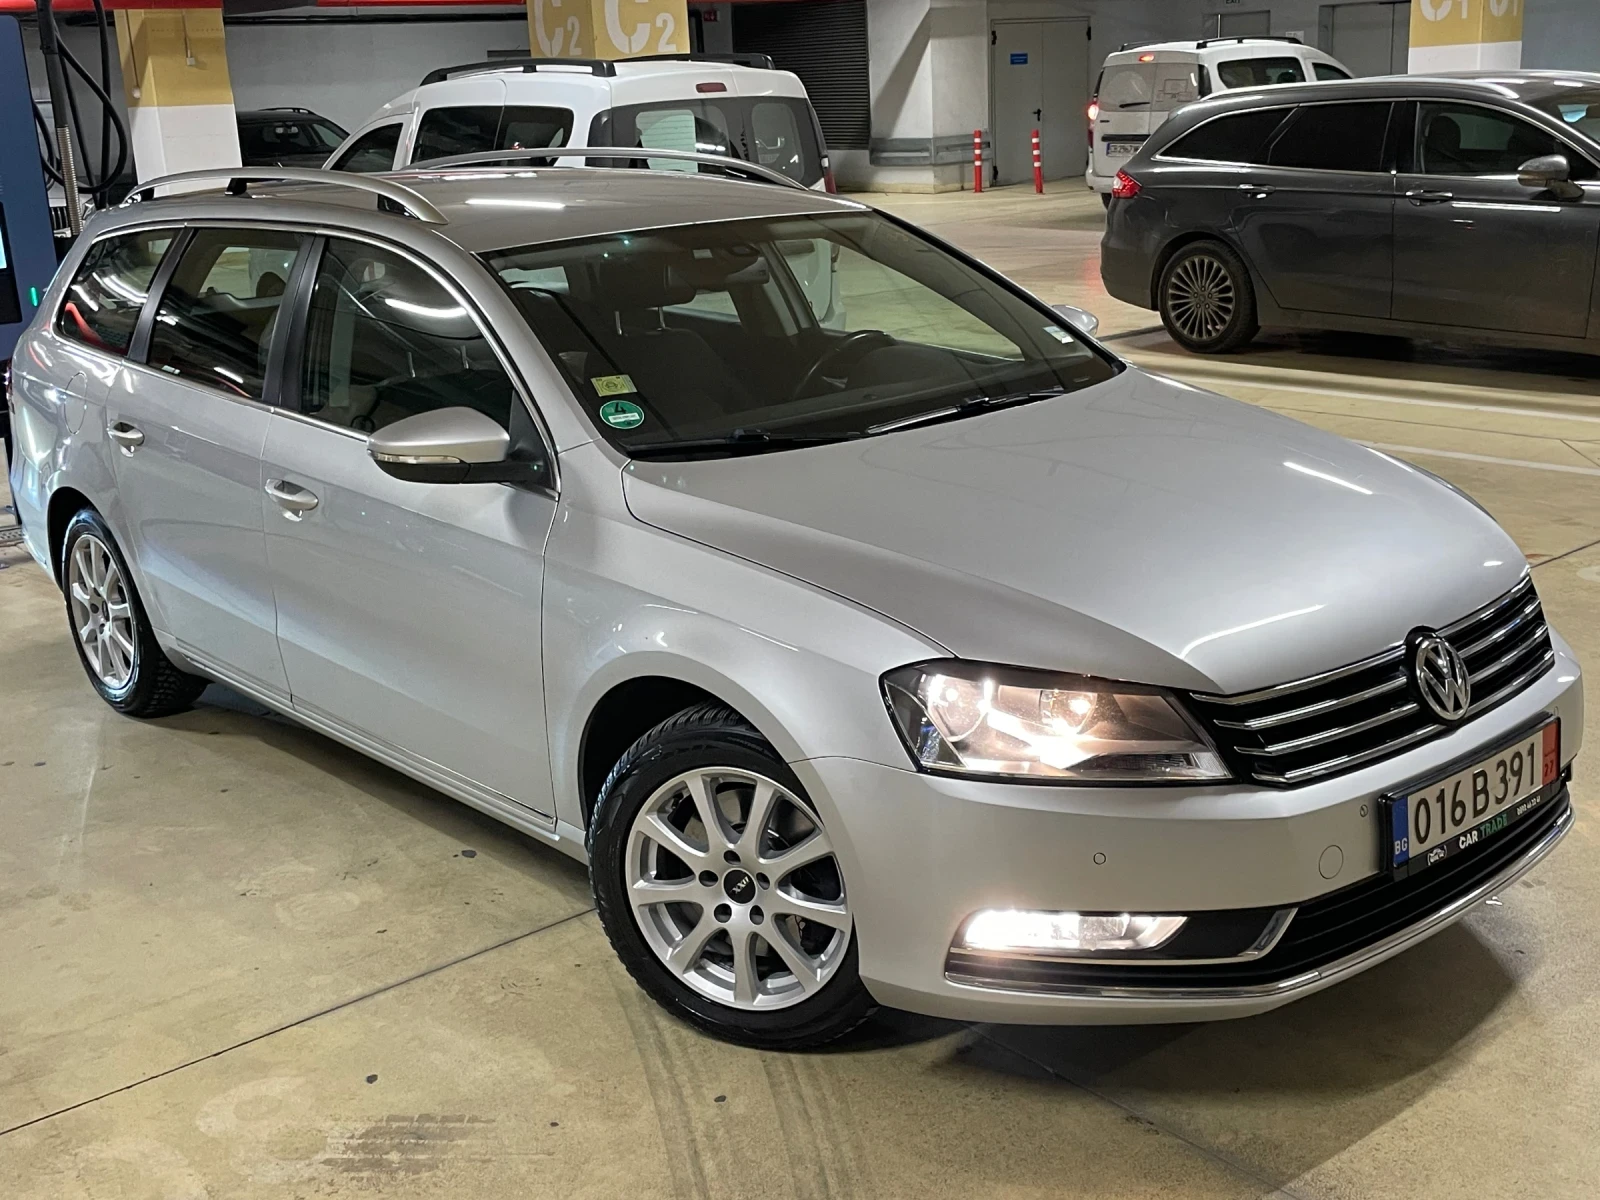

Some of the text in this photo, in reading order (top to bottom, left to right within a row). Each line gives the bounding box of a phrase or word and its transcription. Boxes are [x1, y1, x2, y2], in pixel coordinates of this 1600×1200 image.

[534, 0, 582, 58] C2
[605, 0, 677, 54] C2
[1394, 837, 1408, 855] BG
[1414, 741, 1535, 845] 016B391
[1458, 813, 1509, 849] CAR TRADE
